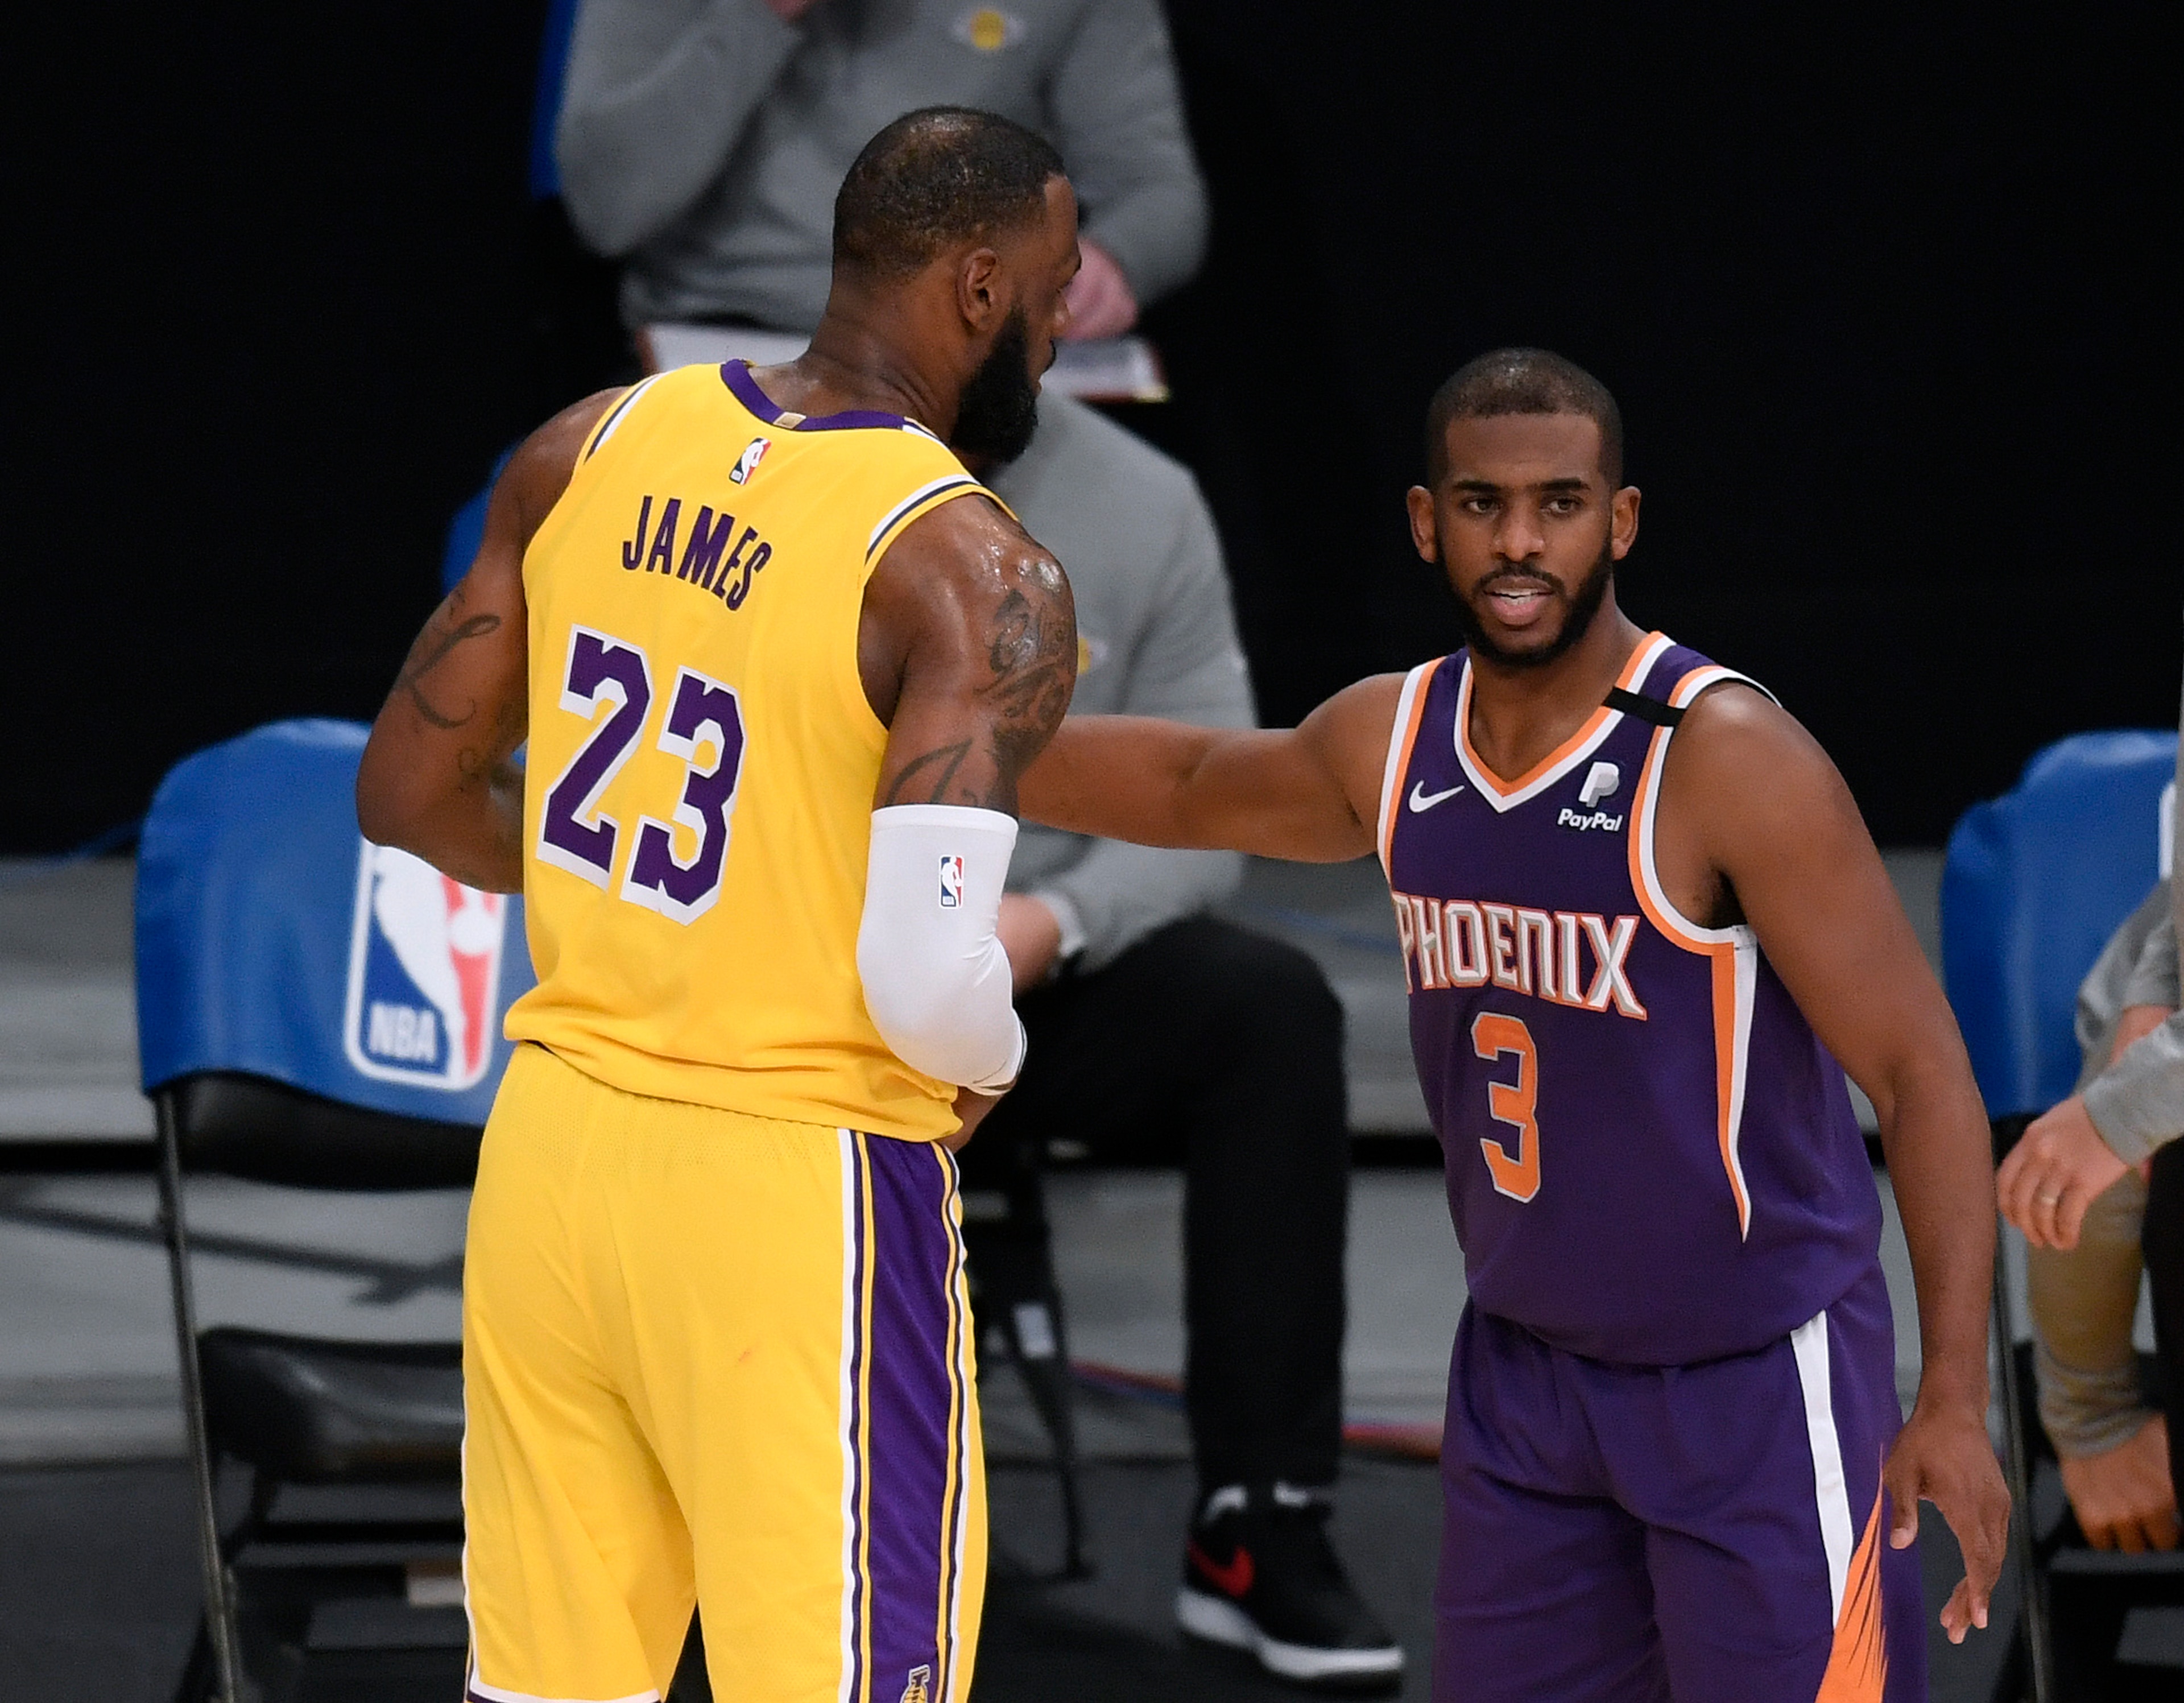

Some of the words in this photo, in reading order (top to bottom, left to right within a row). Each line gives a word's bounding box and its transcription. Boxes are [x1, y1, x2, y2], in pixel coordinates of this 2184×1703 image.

[622, 495, 772, 611] JAMES
[536, 623, 748, 927] 23
[1557, 808, 1623, 832] PayPal
[1392, 891, 1648, 1021] PHOENIX
[371, 1003, 435, 1063] NBA
[1470, 1011, 1542, 1204] 3
